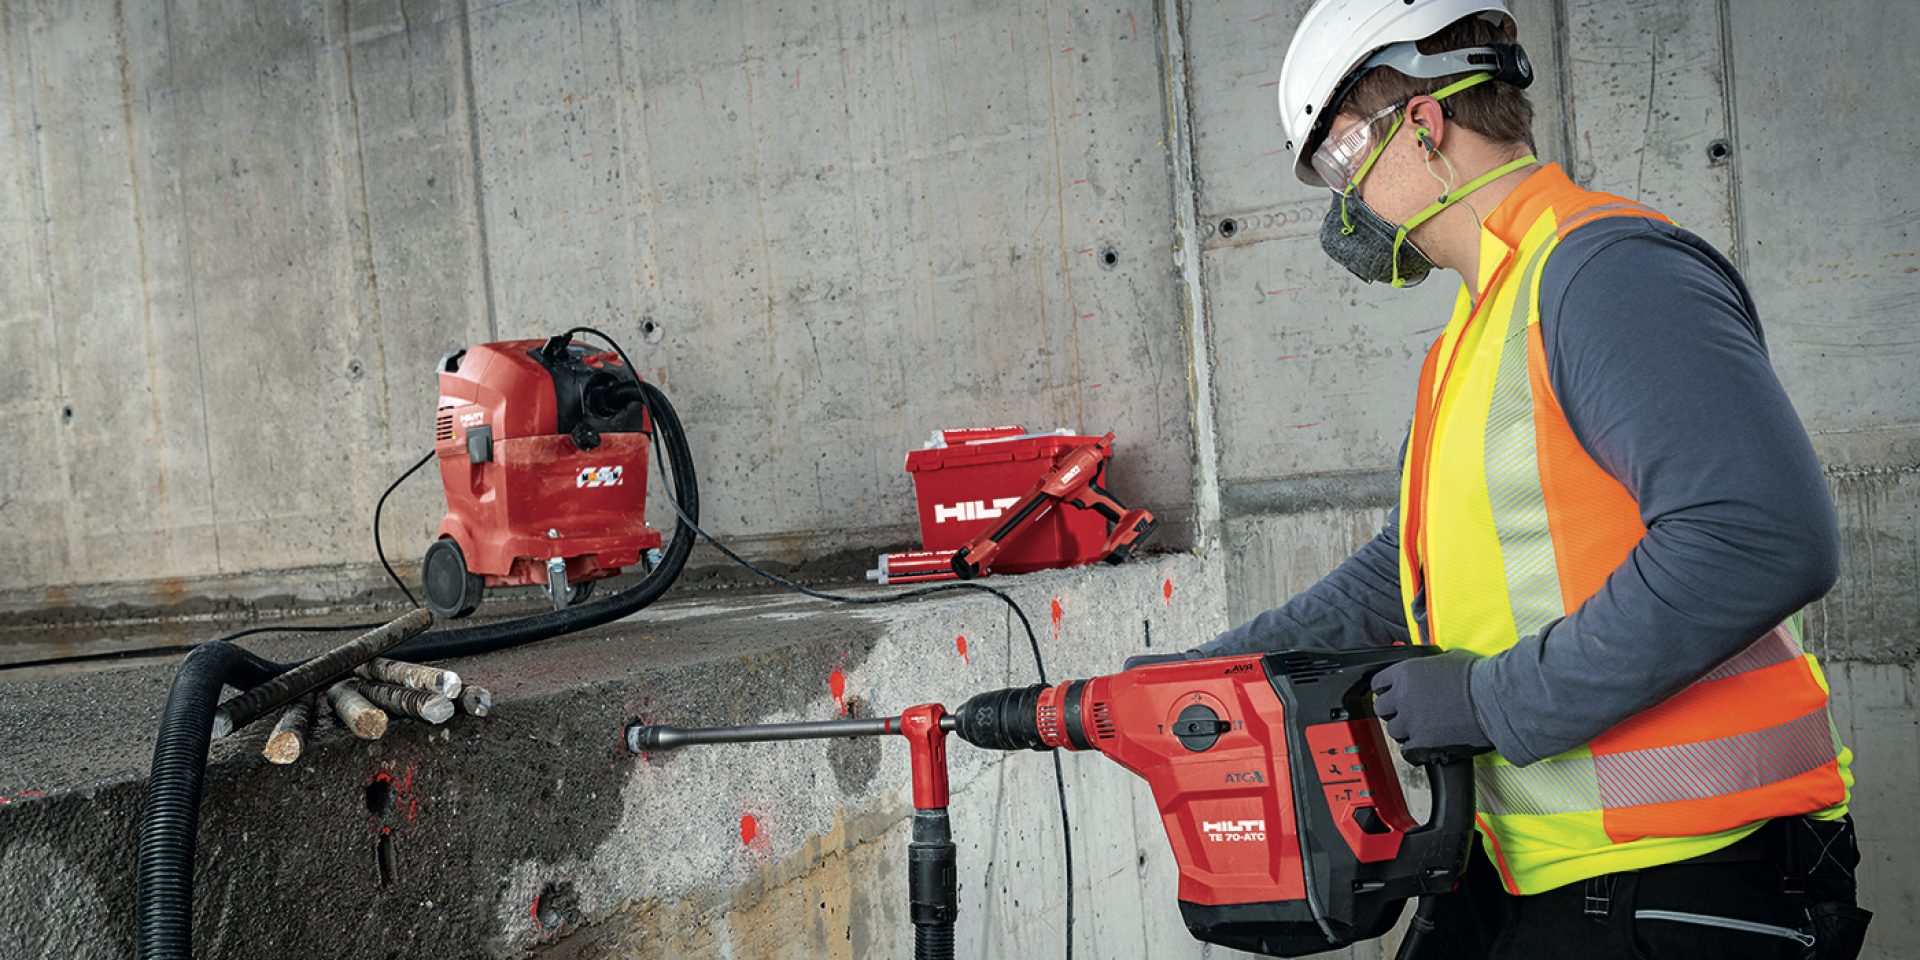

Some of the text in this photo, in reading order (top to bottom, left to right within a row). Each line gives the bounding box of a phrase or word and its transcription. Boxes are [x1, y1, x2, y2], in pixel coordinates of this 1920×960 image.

[934, 496, 1022, 524] HILT
[1202, 819, 1265, 832] HILTI
[1208, 833, 1266, 842] TE 70-ATC
